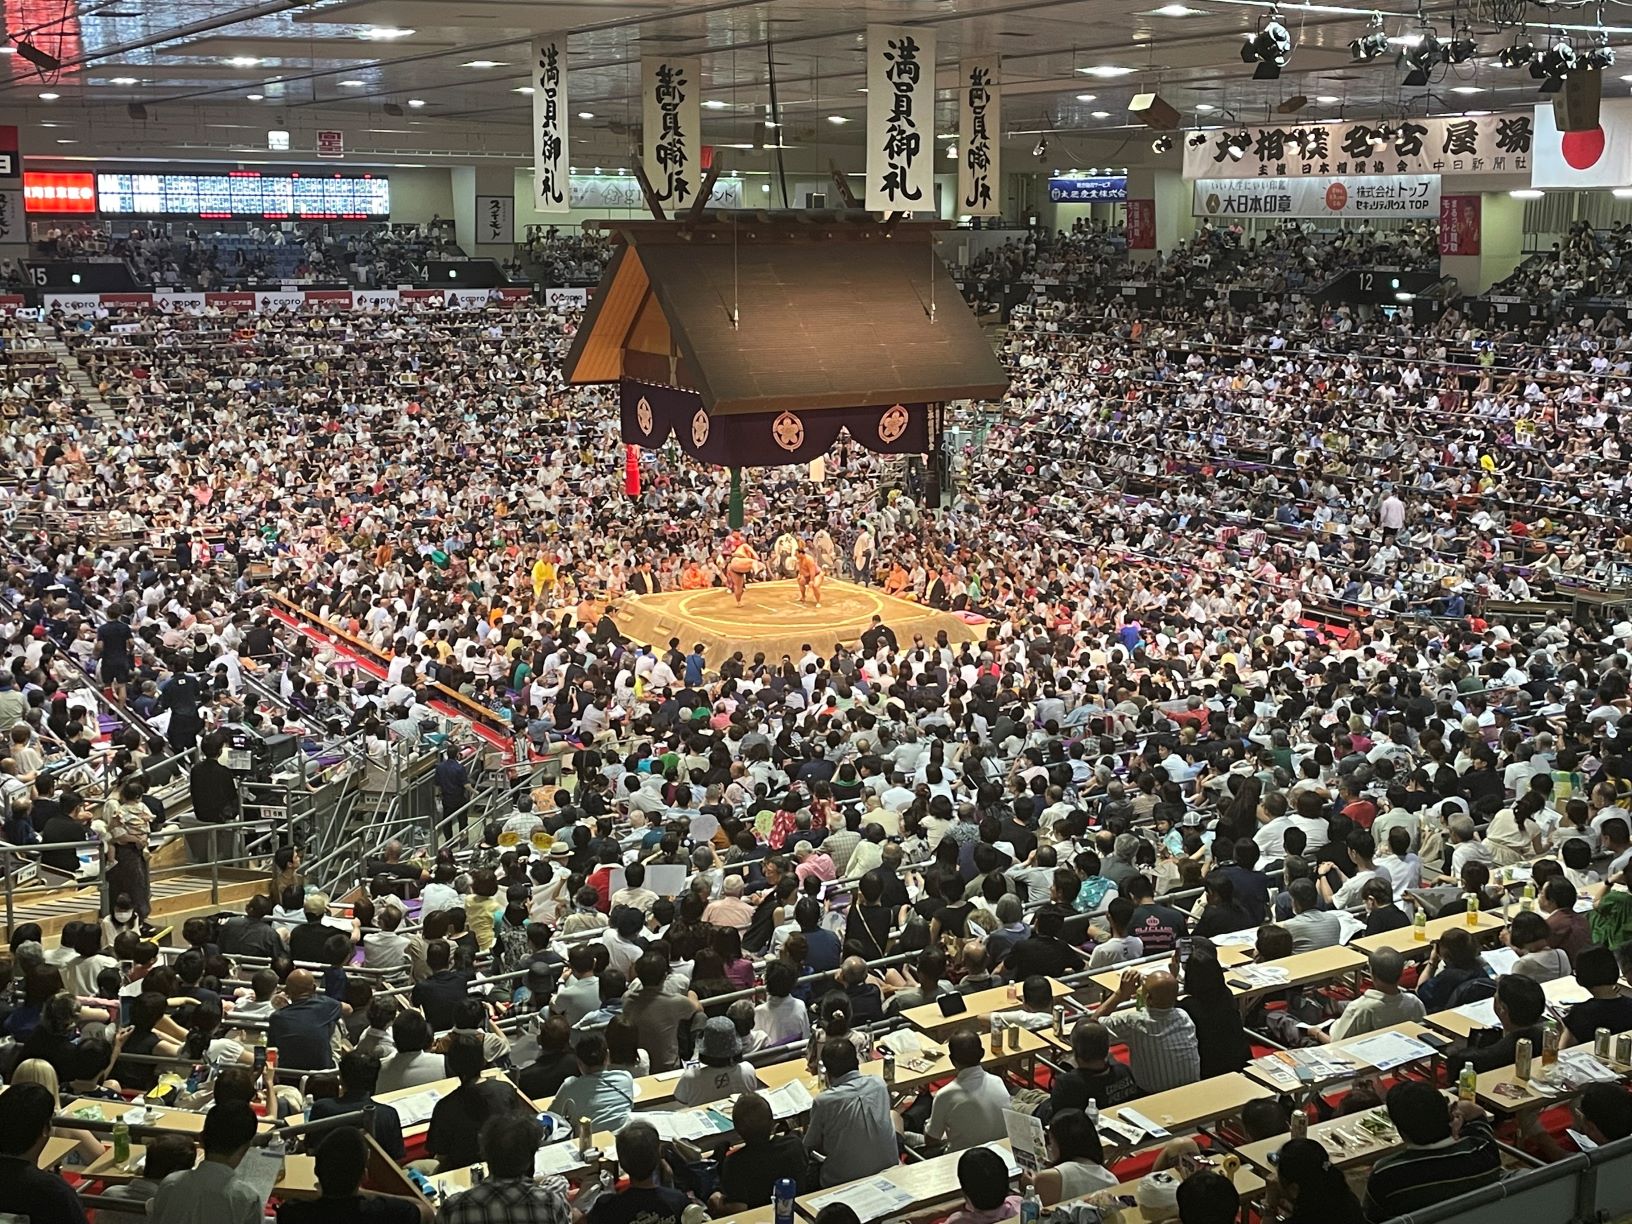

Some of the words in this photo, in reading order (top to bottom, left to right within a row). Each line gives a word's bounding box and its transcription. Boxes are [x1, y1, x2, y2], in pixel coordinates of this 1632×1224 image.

[539, 43, 563, 206] 満員御礼
[880, 36, 923, 202] 満員御礼
[1223, 195, 1292, 213] 大日本印章
[1408, 200, 1429, 210] TOP
[29, 268, 48, 286] 15
[1360, 273, 1373, 291] 12
